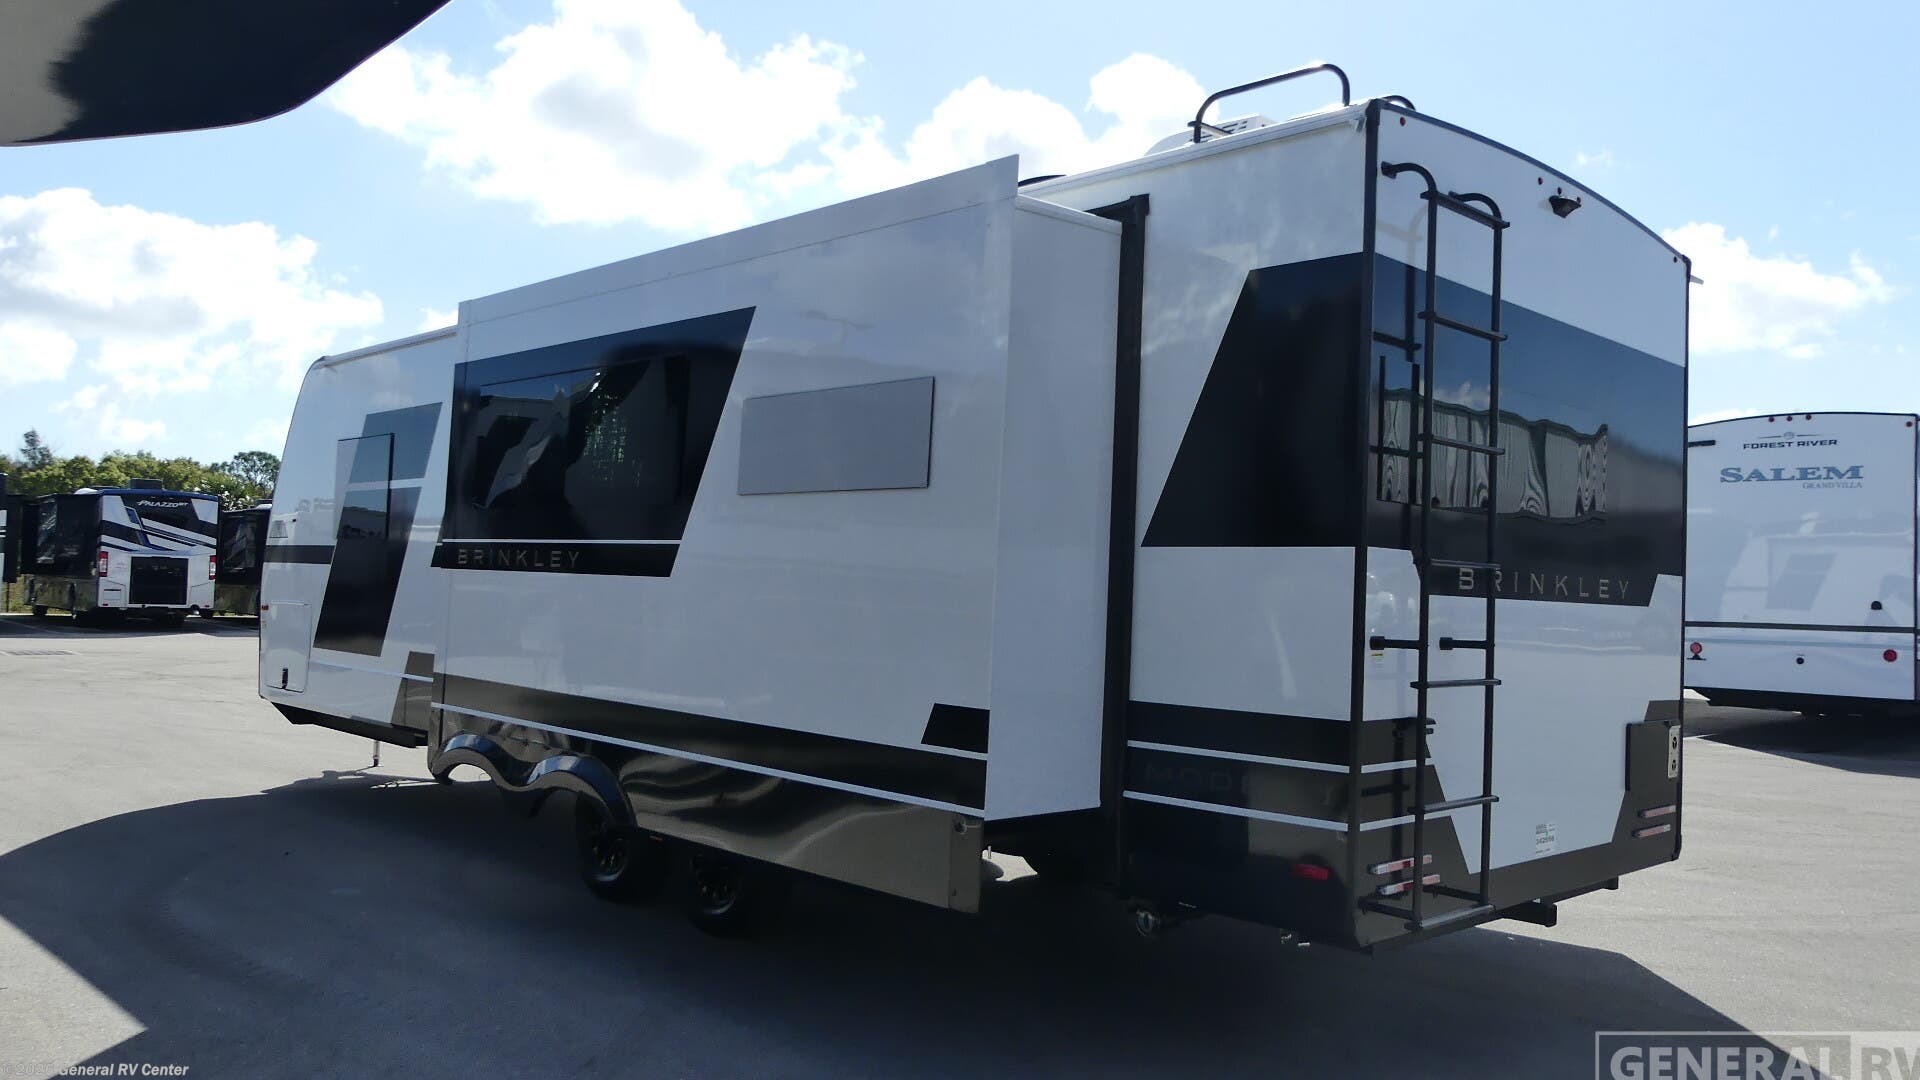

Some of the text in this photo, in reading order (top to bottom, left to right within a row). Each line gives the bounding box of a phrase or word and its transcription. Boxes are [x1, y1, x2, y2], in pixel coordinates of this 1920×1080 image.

[1743, 439, 1838, 450] FOREST RIVER
[1720, 465, 1864, 483] SALEM
[136, 499, 179, 508] PALAZZO
[457, 548, 580, 568] BRINKLEY
[1458, 567, 1629, 599] BRINKLEY
